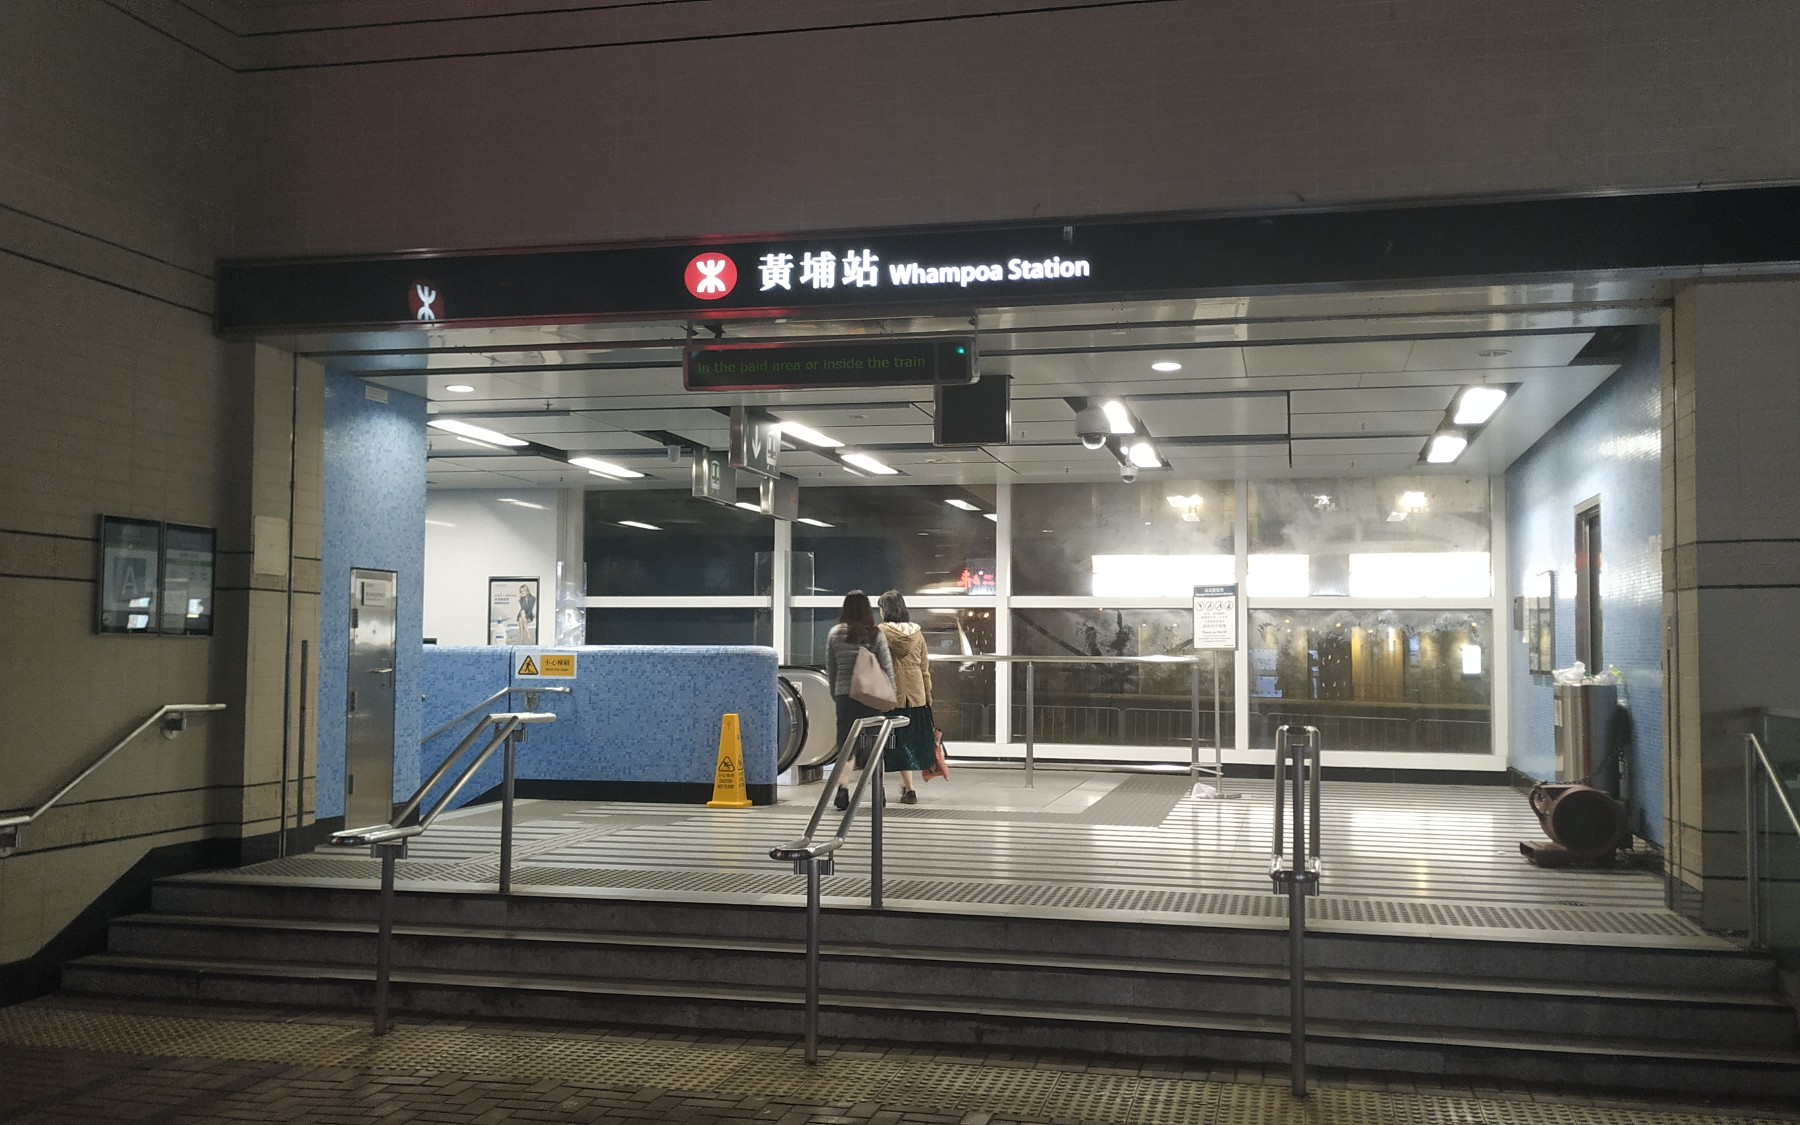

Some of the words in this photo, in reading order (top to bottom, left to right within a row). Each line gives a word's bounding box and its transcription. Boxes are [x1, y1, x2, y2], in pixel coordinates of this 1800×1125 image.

[757, 248, 880, 291] 黃埔站
[889, 263, 1003, 287] Whampoa
[1008, 256, 1090, 280] Station
[697, 361, 710, 373] in
[714, 361, 736, 373] the
[740, 360, 768, 374] paid
[772, 361, 801, 372] area
[805, 360, 818, 370] or
[823, 357, 864, 370] inside
[867, 356, 890, 369] the
[894, 355, 926, 368] train
